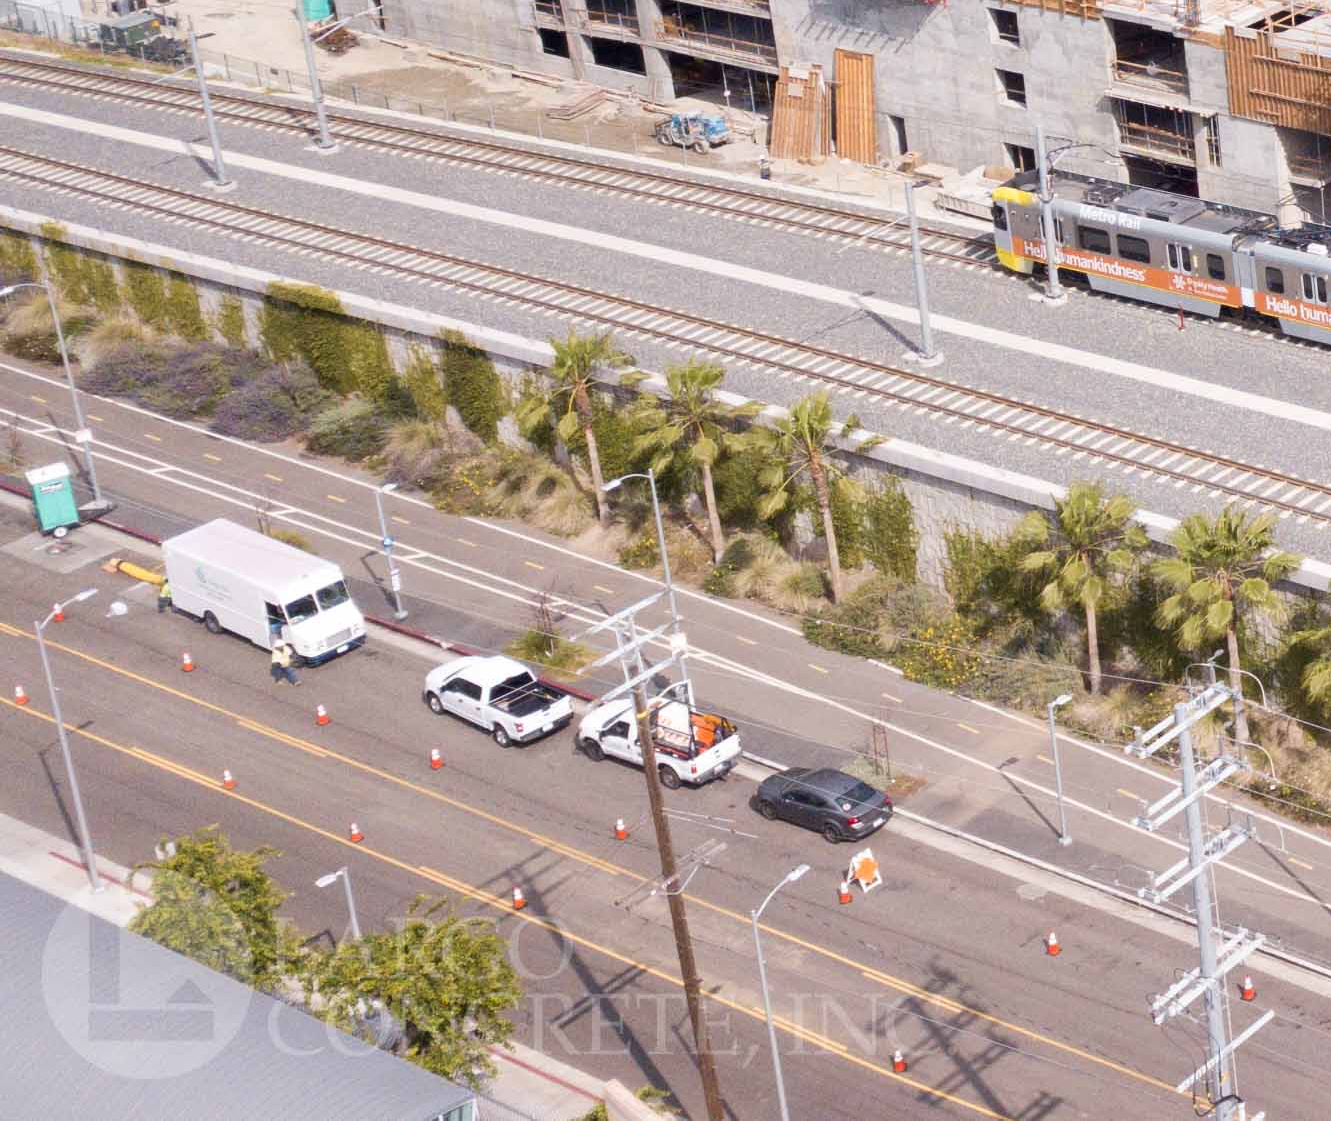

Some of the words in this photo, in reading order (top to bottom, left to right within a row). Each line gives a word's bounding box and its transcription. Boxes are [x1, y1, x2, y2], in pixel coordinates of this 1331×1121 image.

[1079, 205, 1117, 225] Metro
[1118, 212, 1141, 229] Rail
[1266, 295, 1297, 316] Hello
